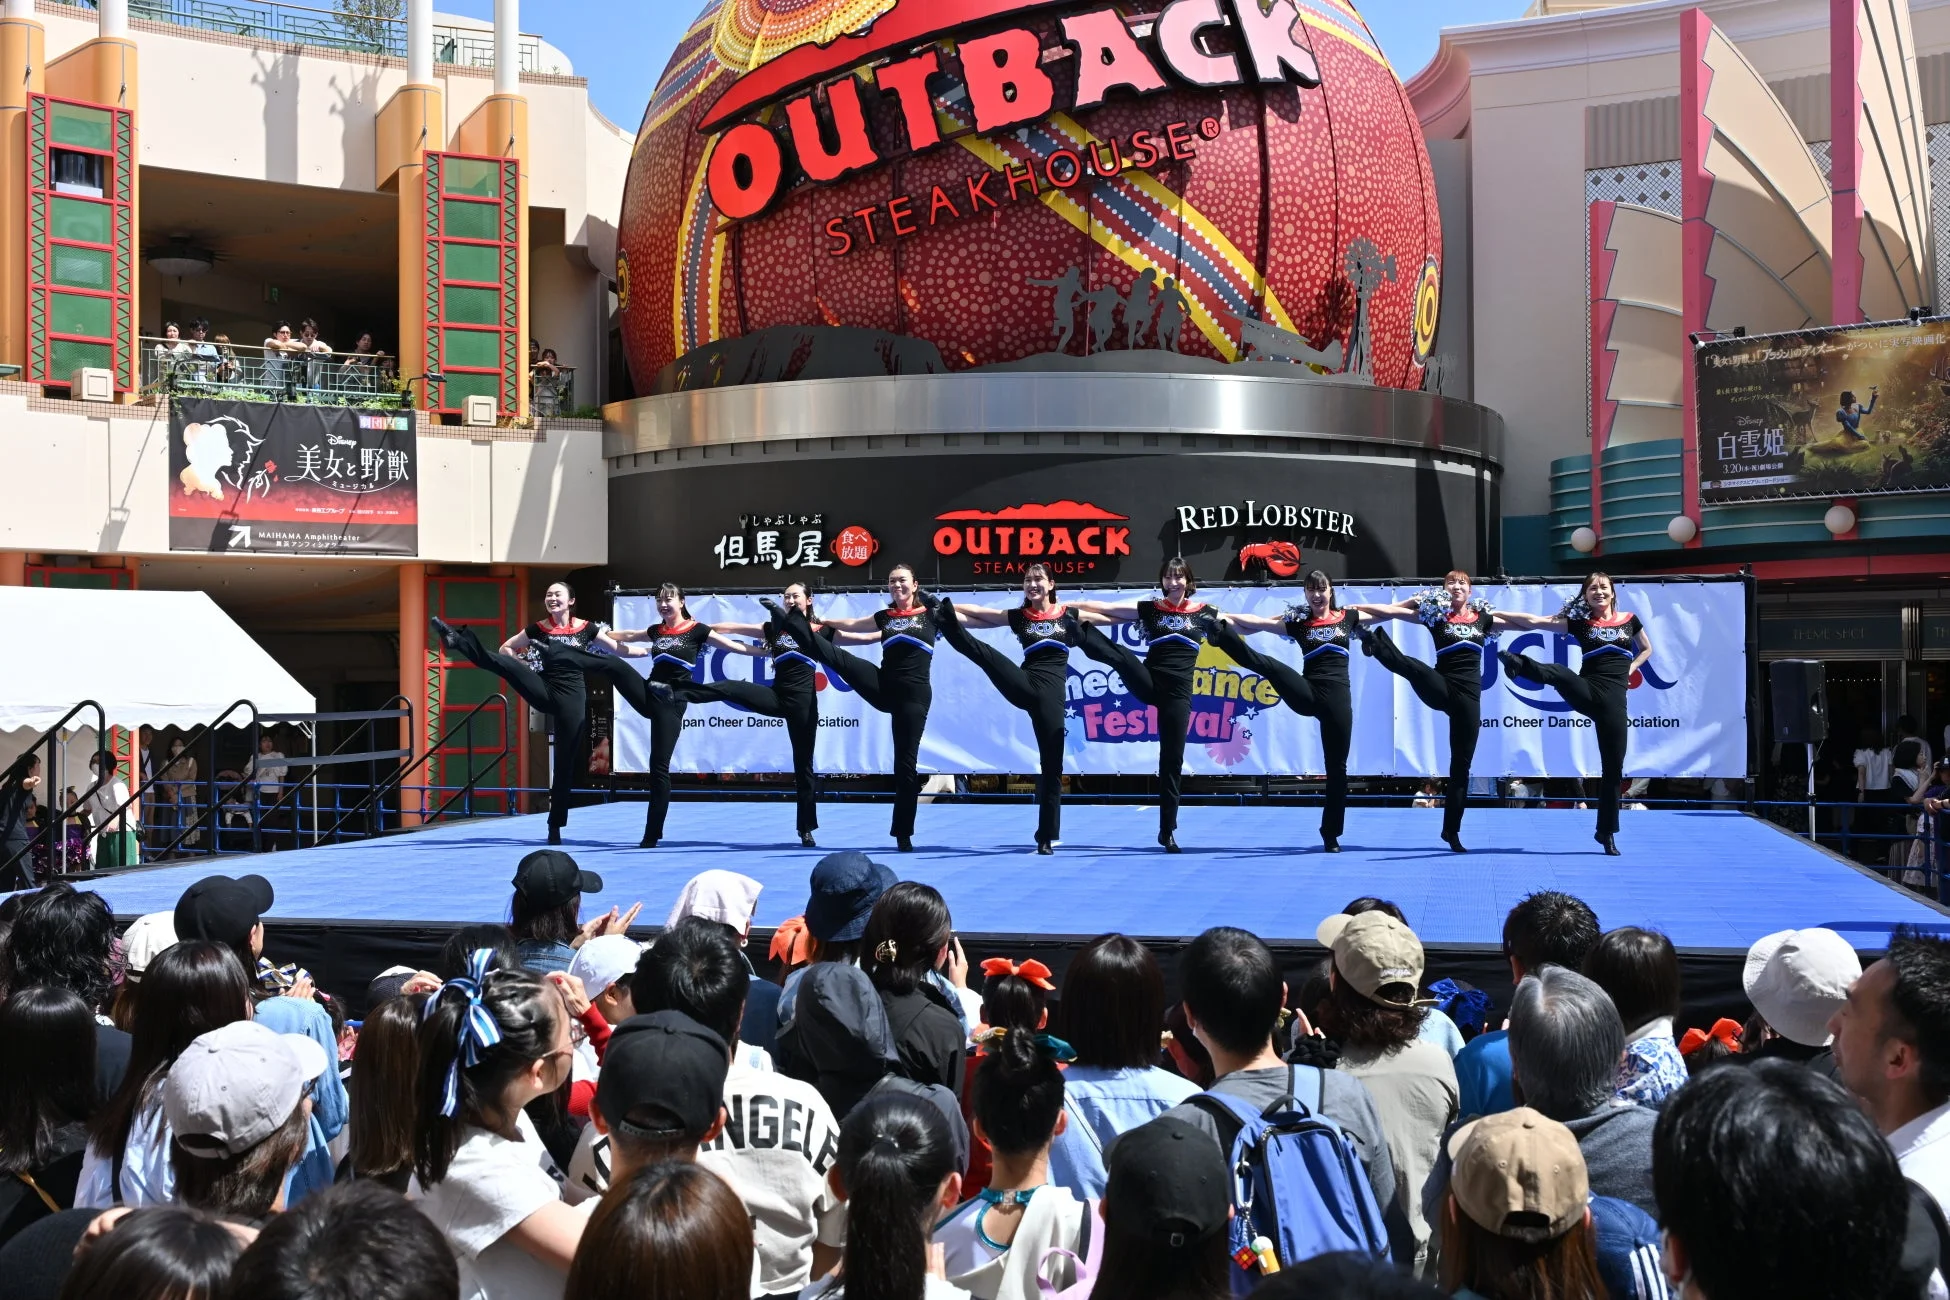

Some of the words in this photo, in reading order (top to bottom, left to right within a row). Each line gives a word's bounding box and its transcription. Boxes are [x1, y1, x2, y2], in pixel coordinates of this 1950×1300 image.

[704, 0, 1322, 222] OUTBACK
[1736, 416, 1764, 427] Disney
[326, 433, 358, 449] Disney
[1717, 428, 1789, 461] 白雪姫
[296, 443, 410, 482] 美女と野獣
[752, 513, 822, 527] しゃぶしゃぶ
[1177, 505, 1239, 533] RED
[1245, 500, 1357, 537] LOBSTER
[258, 532, 302, 540] MAIHAMA
[304, 533, 361, 541] Amphitheater
[841, 530, 868, 545] 食べ
[933, 526, 1131, 557] OUTBACK
[713, 530, 834, 570] 但馬屋
[840, 545, 868, 561] 放題
[1027, 622, 1066, 636] JCDA
[1306, 626, 1346, 641] JCDA
[1445, 624, 1483, 638] JCDA
[1587, 627, 1630, 641] JCDA
[1192, 668, 1280, 705] ance
[682, 717, 705, 730] pan
[708, 716, 744, 727] Cheer
[747, 716, 784, 727] Dance
[818, 716, 859, 727] ciation
[1503, 716, 1544, 728] Cheer
[1549, 716, 1592, 728] Dance
